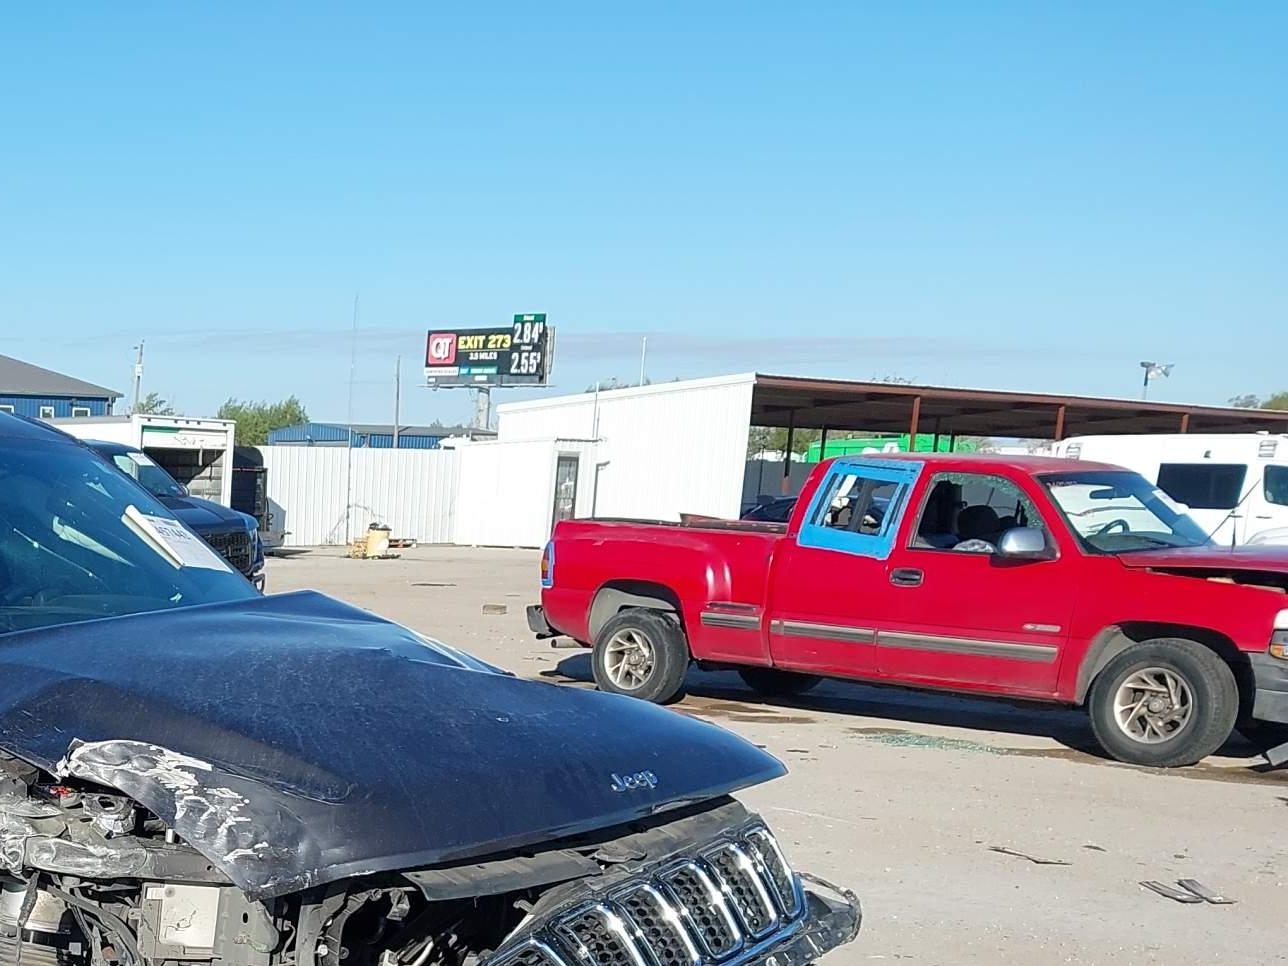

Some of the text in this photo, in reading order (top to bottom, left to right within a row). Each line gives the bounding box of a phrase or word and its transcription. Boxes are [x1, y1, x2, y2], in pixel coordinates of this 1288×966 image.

[431, 337, 452, 360] QT
[457, 334, 512, 349] EXIT 273
[611, 770, 658, 792] Jeep
